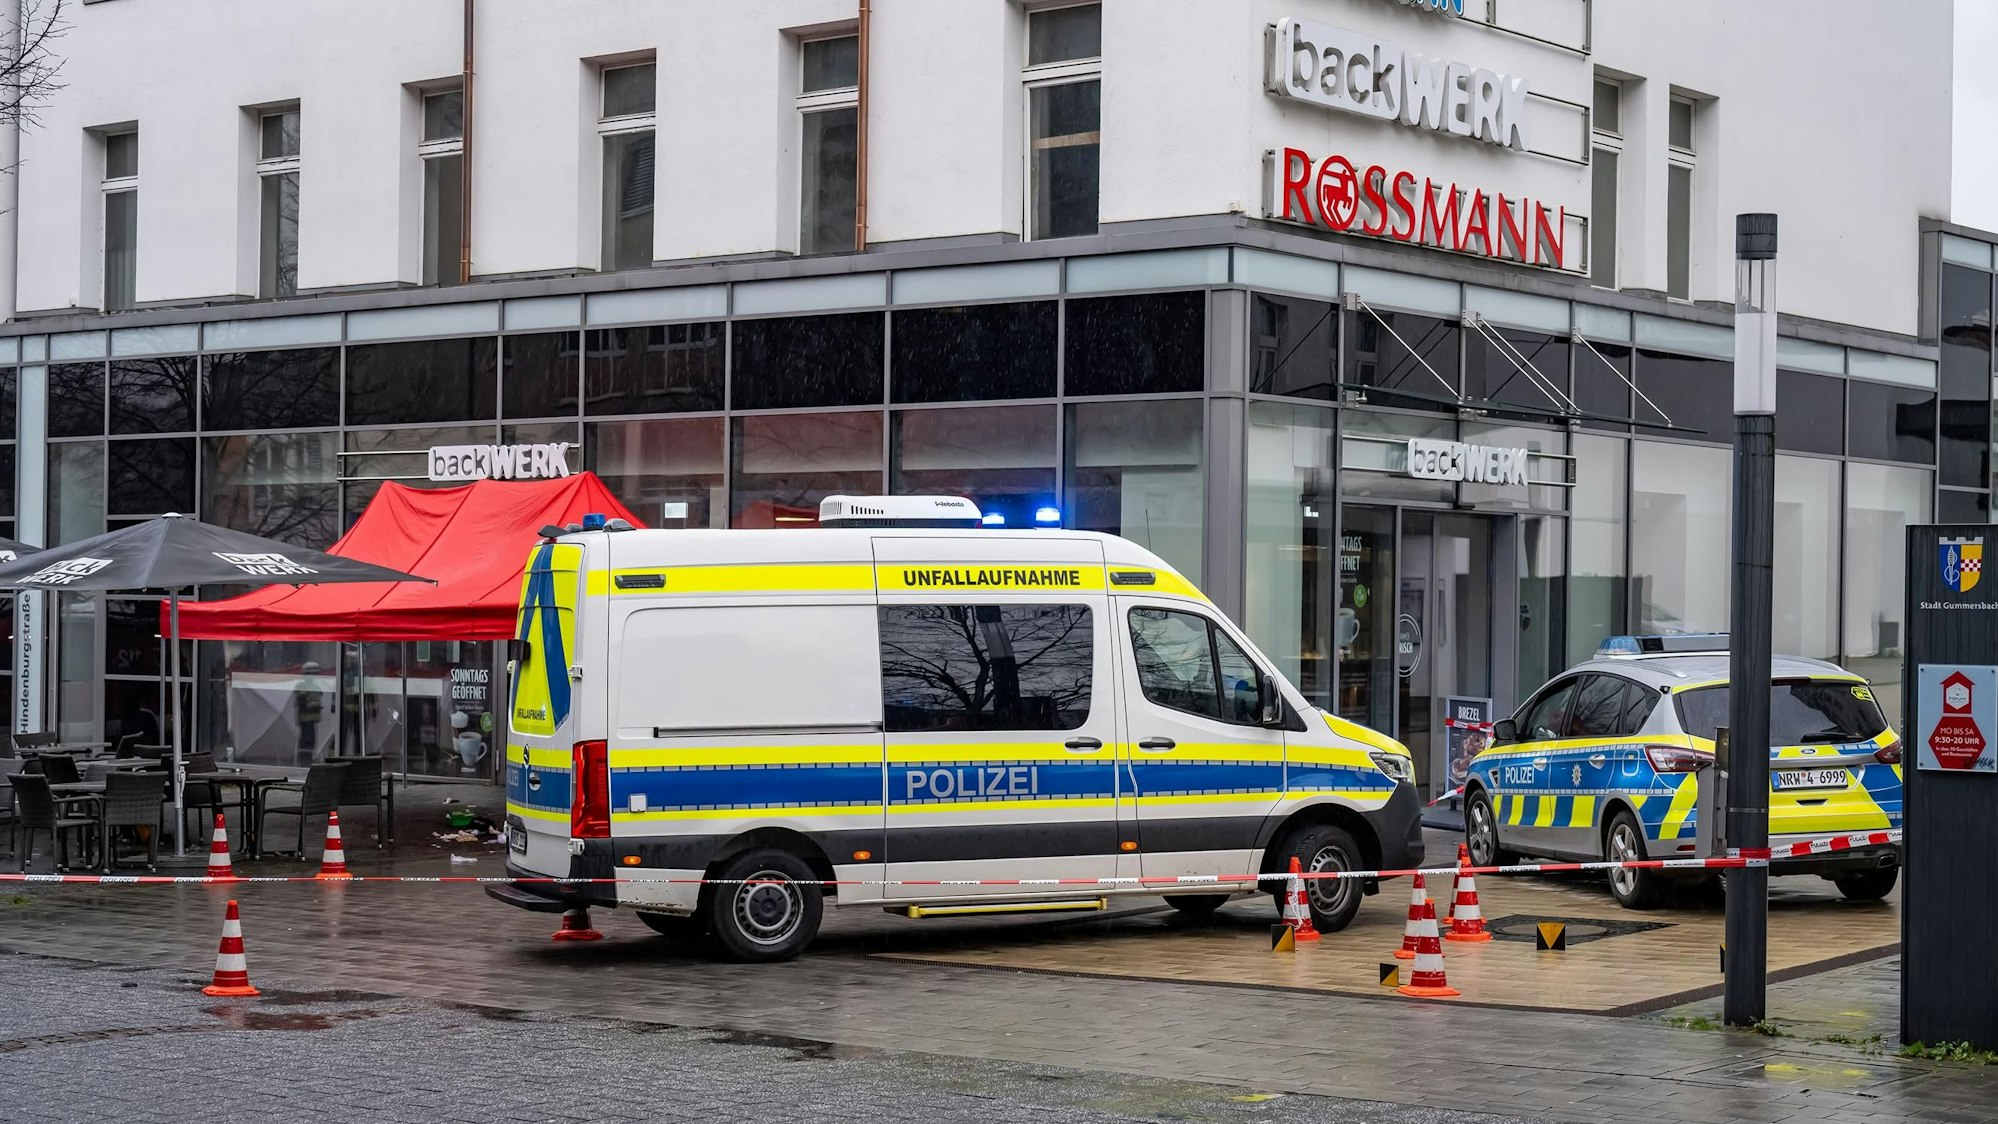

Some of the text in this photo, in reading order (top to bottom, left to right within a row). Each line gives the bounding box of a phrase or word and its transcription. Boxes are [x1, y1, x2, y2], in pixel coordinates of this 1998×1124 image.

[1292, 22, 1530, 151] backWERK
[1283, 146, 1565, 269] ROSSMANN
[433, 441, 570, 481] backWERK
[1413, 441, 1528, 487] backWERK
[1340, 536, 1363, 552] NTAGS
[1340, 556, 1361, 571] FFNET
[903, 569, 1081, 587] UNFALLAUFNAHME
[1920, 601, 1942, 610] Stadt
[20, 594, 32, 734] Hindenburgstraße
[450, 668, 489, 683] SONNTAGS
[452, 683, 487, 700] GEÖFFNET
[1457, 705, 1480, 721] BREZEL
[1940, 727, 1974, 735] MO BIS SA
[1964, 737, 1980, 745] UHR
[906, 766, 1038, 799] POLIZEI
[1505, 766, 1535, 784] POLIZEI
[1779, 769, 1846, 786] NRW 4-6999
